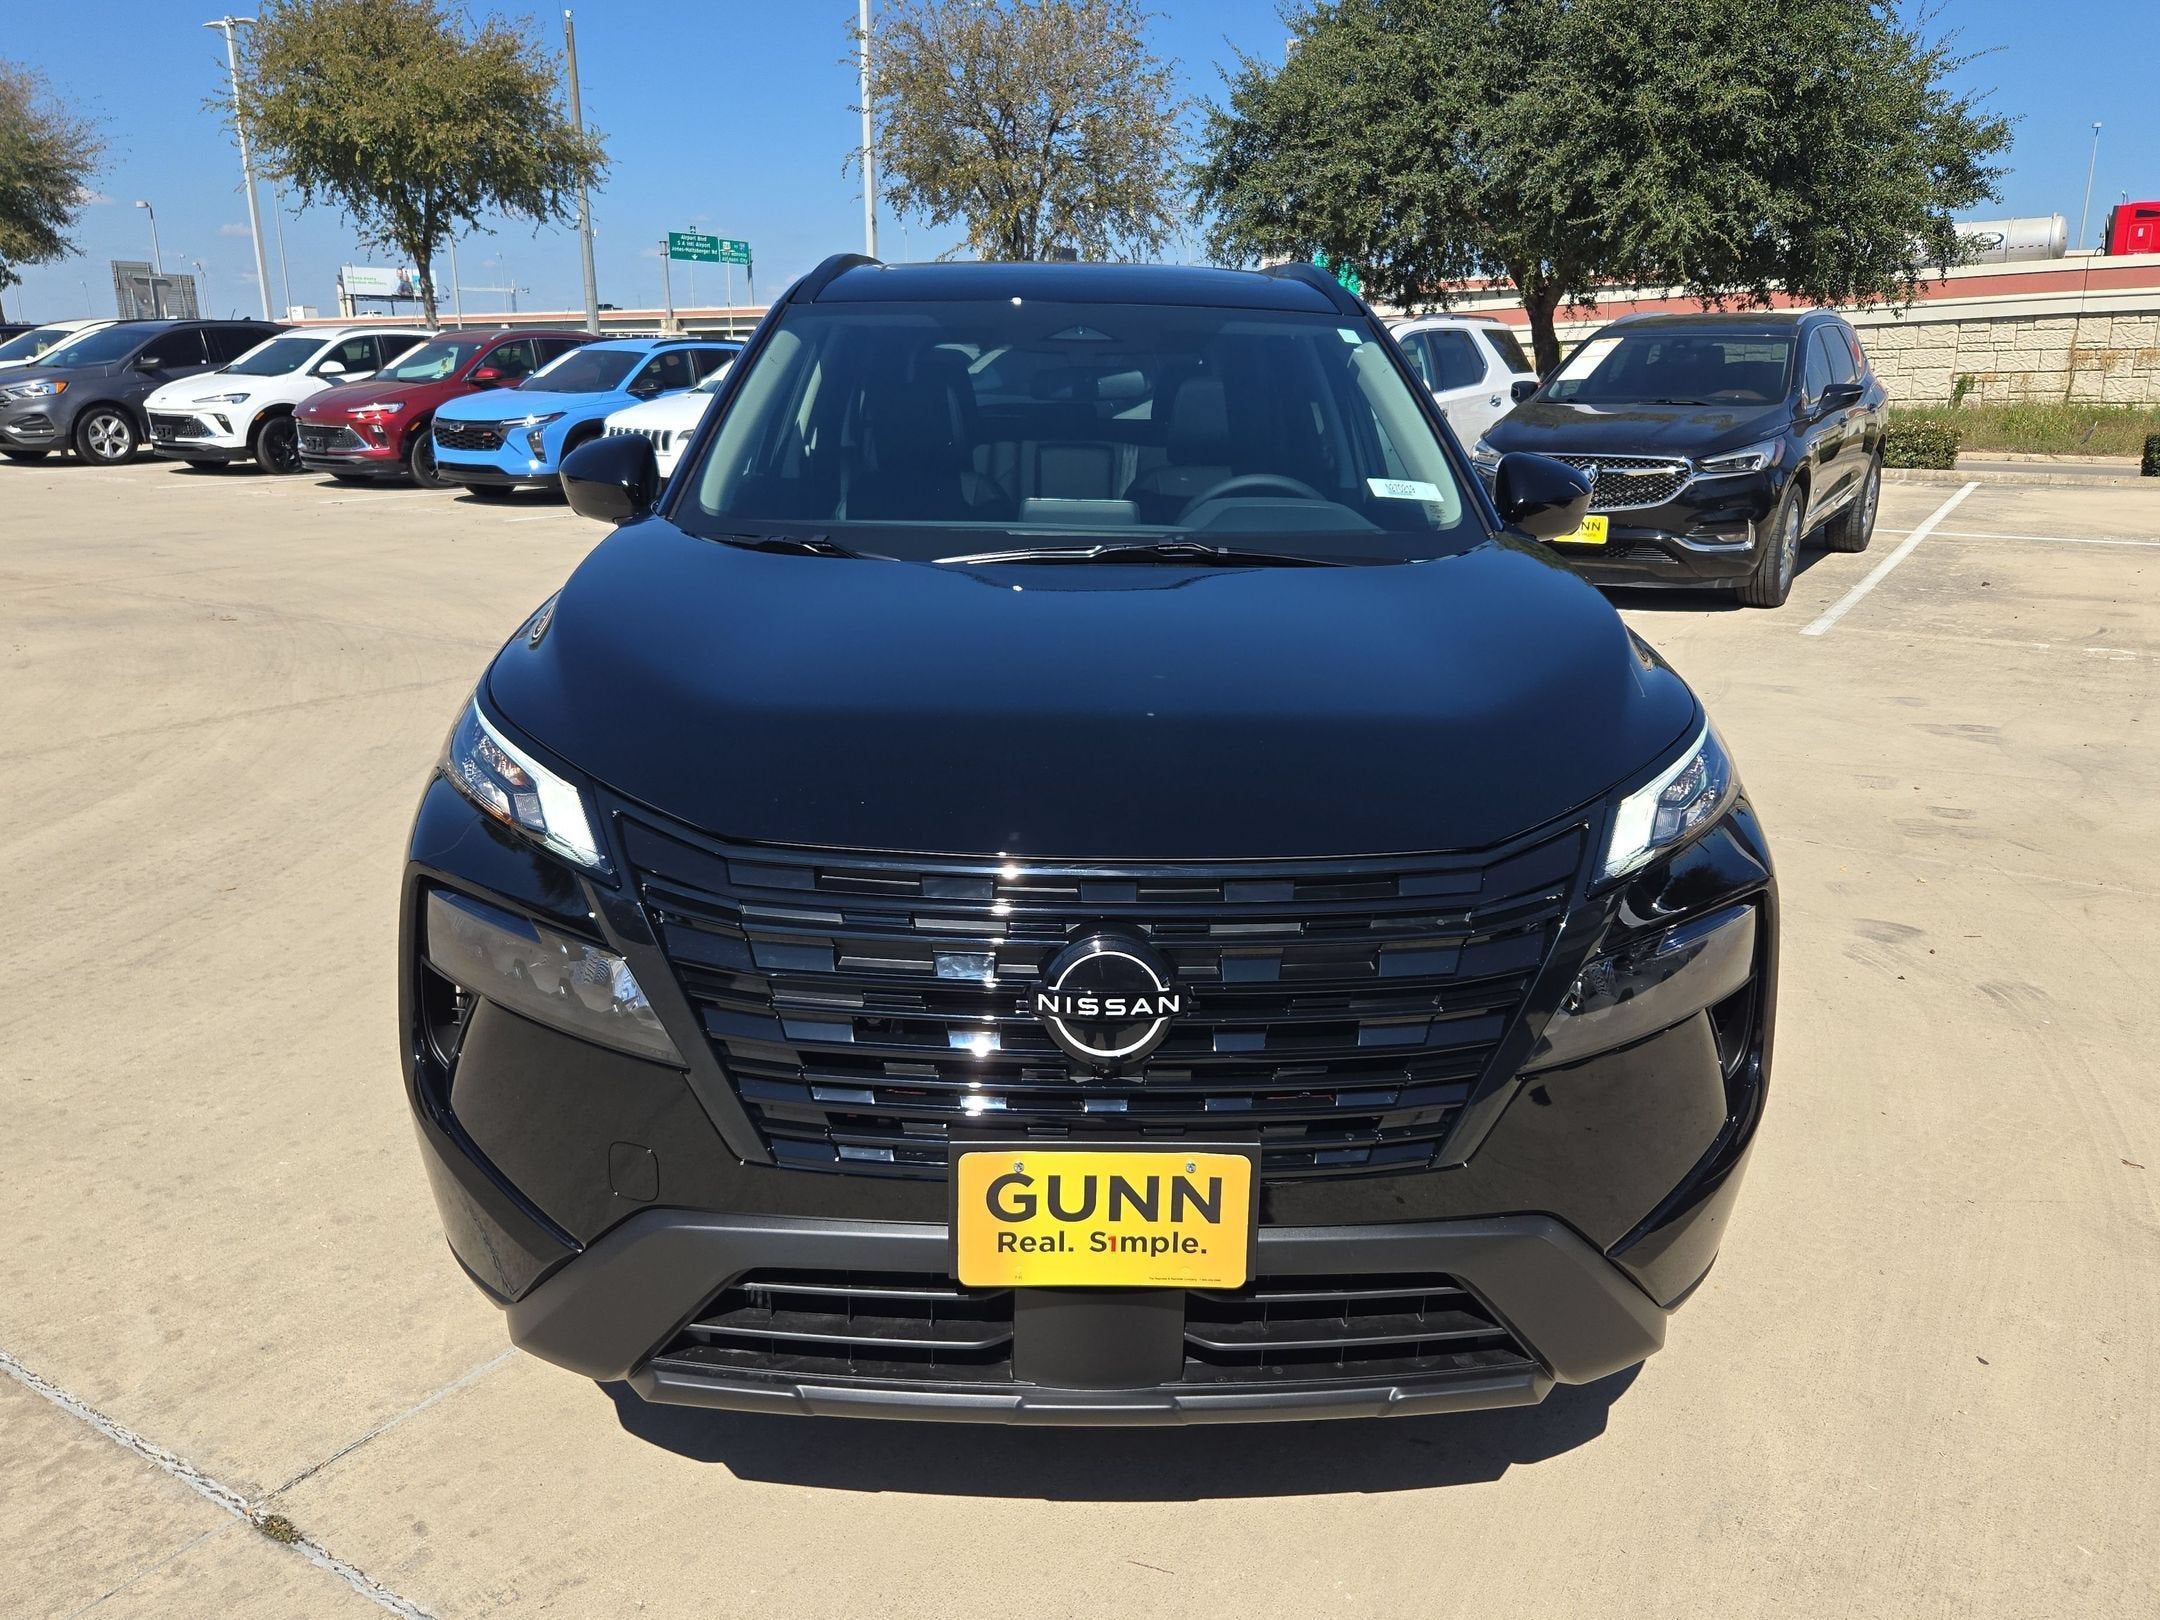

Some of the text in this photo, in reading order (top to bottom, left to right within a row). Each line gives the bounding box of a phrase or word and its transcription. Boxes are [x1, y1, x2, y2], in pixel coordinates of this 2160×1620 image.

[1037, 993, 1180, 1016] NISSAN
[985, 1171, 1223, 1224] GUNN
[998, 1231, 1074, 1253] Real.
